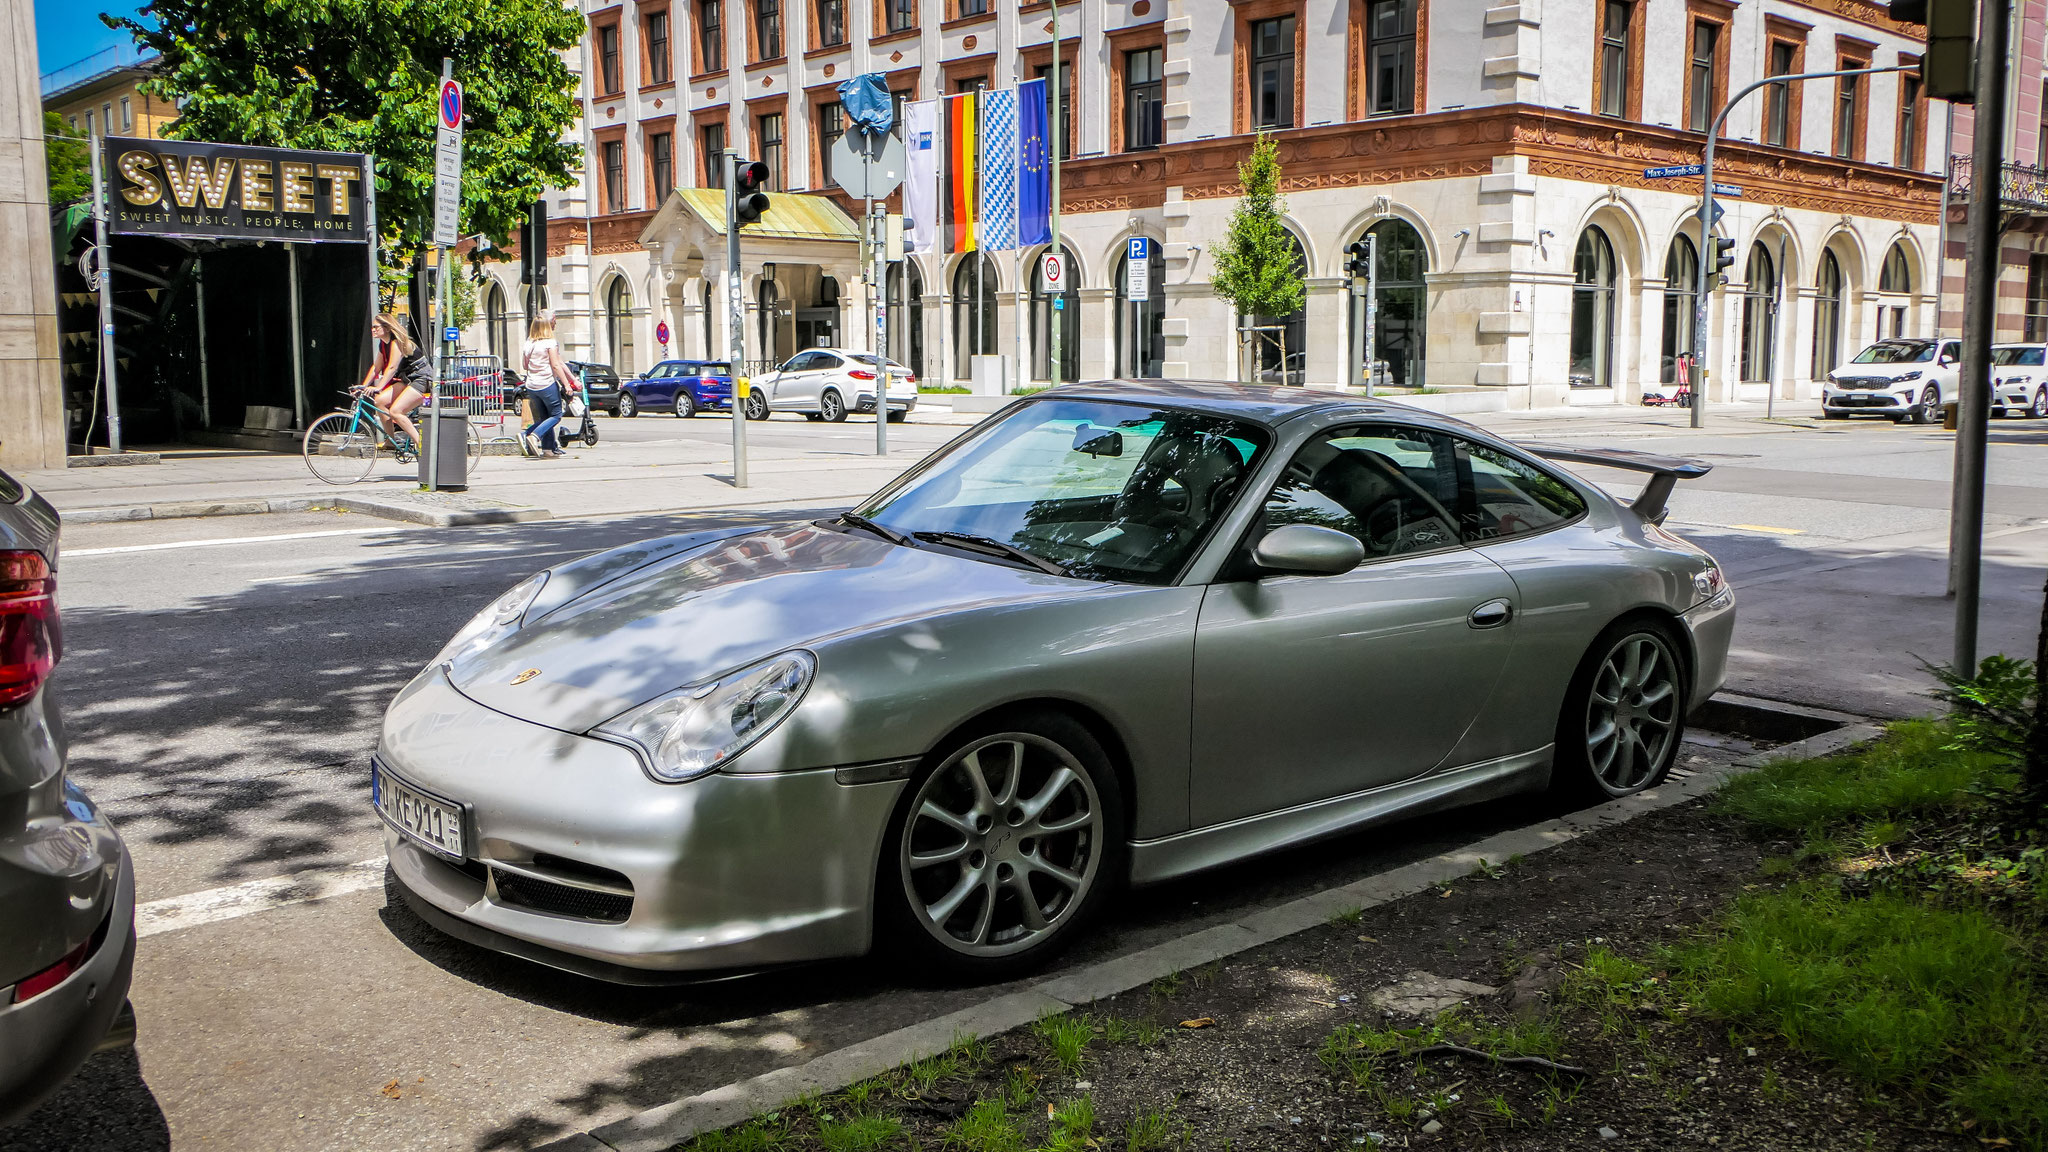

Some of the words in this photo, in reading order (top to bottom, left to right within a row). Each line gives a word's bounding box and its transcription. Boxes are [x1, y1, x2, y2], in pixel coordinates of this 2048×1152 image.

[1646, 165, 1700, 178] Max-Joseph-Str.
[117, 150, 360, 215] SWEET
[120, 211, 171, 223] SWEET
[314, 220, 353, 231] HOME
[1048, 263, 1057, 275] 30
[1048, 282, 1059, 290] ZONE
[990, 831, 1010, 854] GT3
